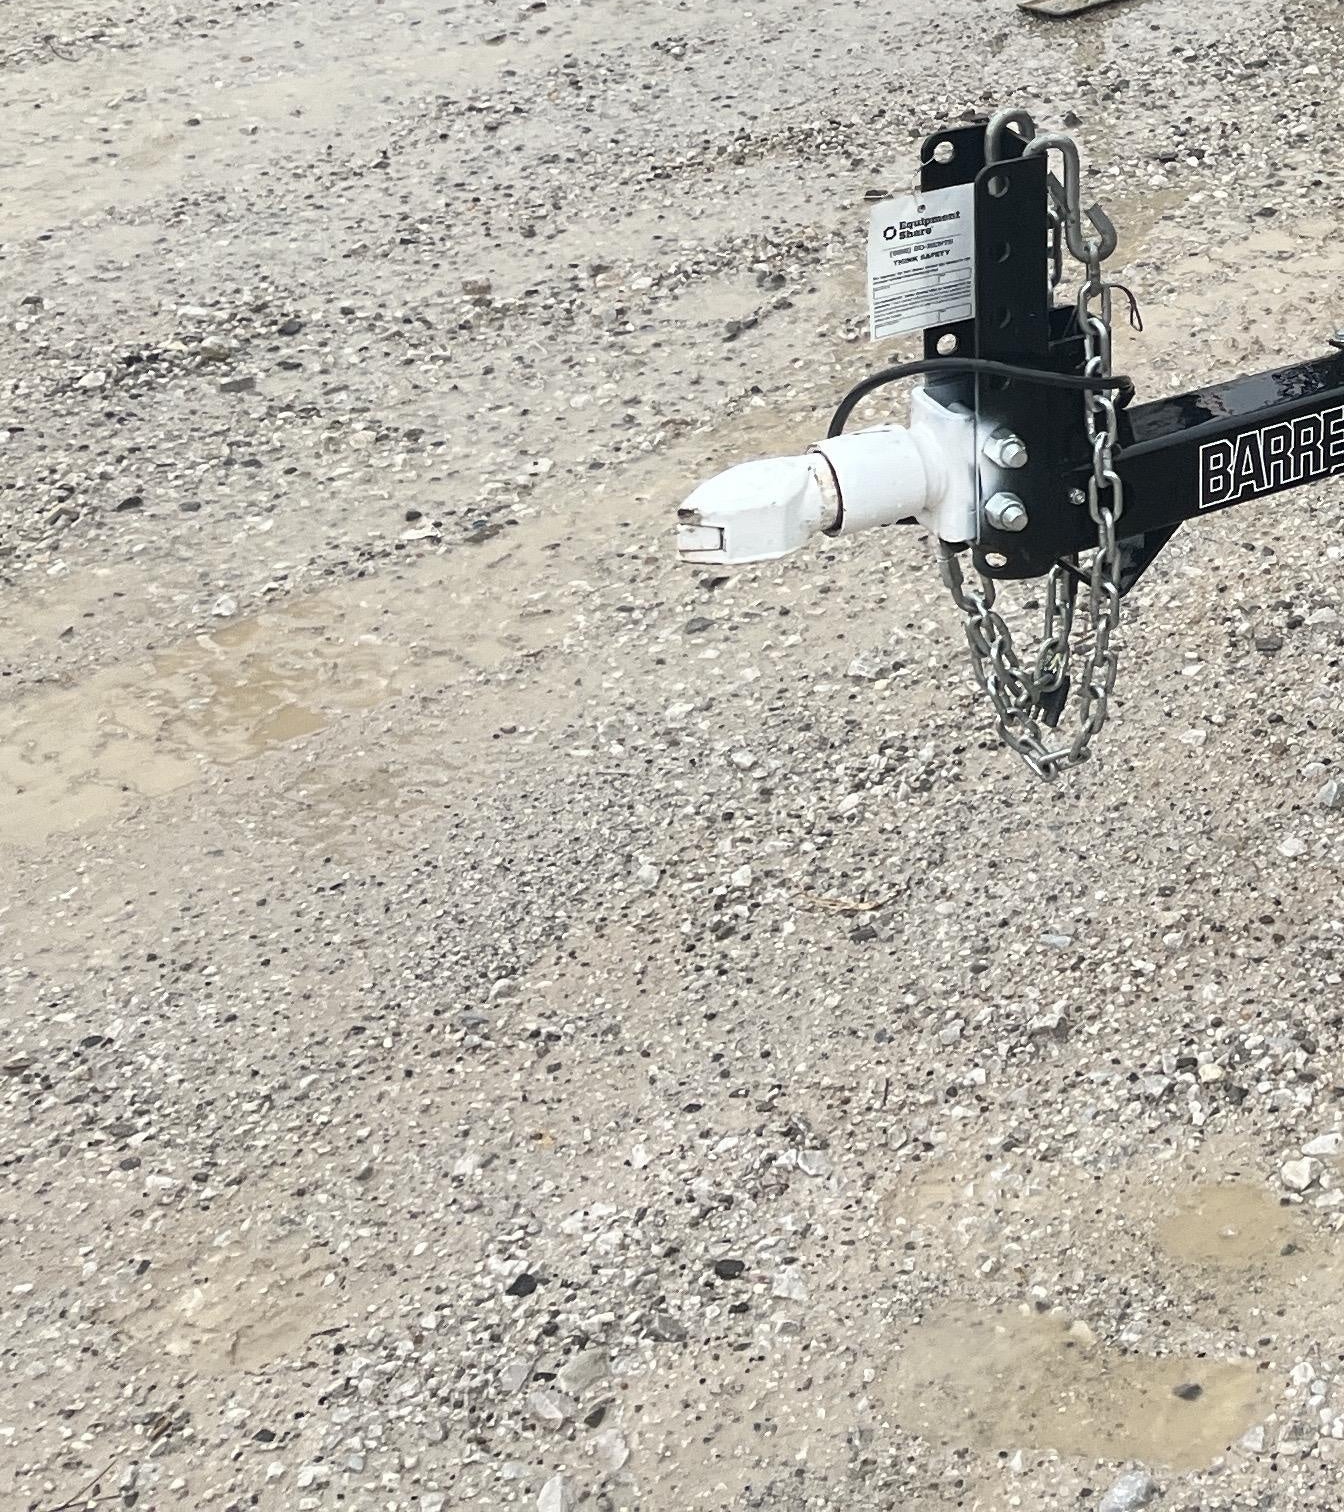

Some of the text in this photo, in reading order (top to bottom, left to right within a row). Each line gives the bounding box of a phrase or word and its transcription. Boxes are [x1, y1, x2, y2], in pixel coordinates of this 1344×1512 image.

[899, 210, 961, 231] Equipment
[899, 226, 932, 240] Share
[893, 249, 951, 267] THINK SAFETY
